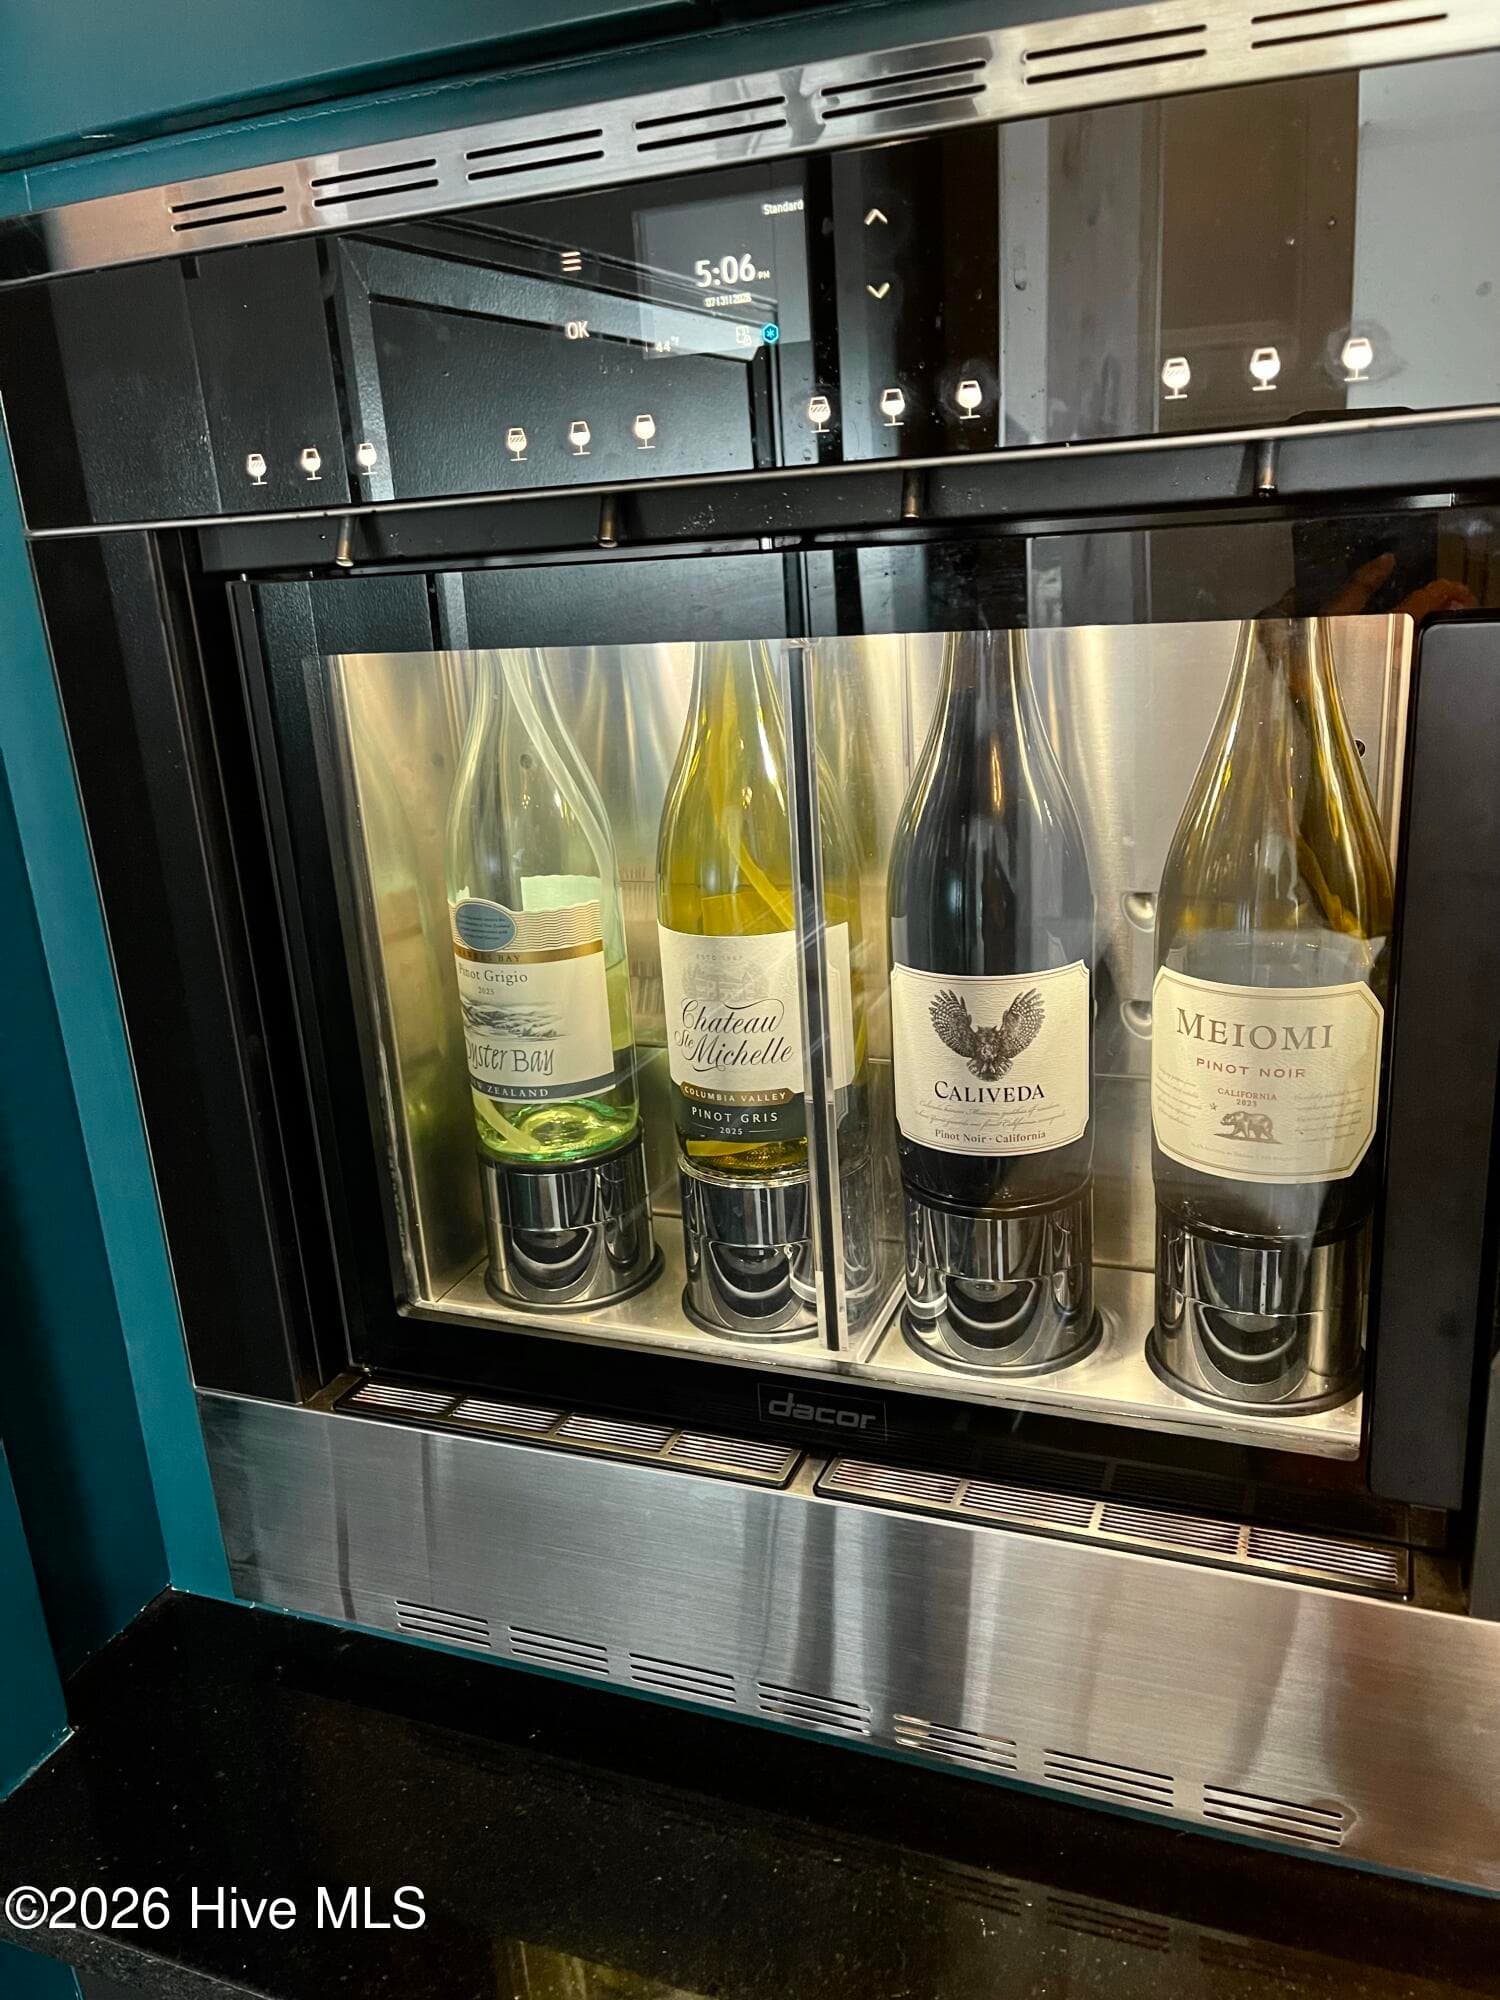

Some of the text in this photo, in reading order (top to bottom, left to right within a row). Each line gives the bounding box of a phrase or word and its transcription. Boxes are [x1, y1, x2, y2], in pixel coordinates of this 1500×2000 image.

[762, 199, 804, 215] Standard
[695, 254, 771, 287] 5:06 PM
[565, 321, 590, 340] OK
[484, 969, 528, 987] Grigio
[681, 998, 784, 1034] Chateau
[1176, 1007, 1334, 1051] MEIOMI
[510, 1048, 554, 1076] Bay
[682, 1034, 795, 1072] Michelle
[1196, 1057, 1306, 1078] PINOT NOIR
[487, 1085, 549, 1097] ZEALAND
[684, 1086, 786, 1102] COLUMBIA VALLEY
[1217, 1087, 1277, 1101] CALIFORNIA
[691, 1106, 778, 1123] PINOT GRIS
[720, 1127, 743, 1135] 2025
[935, 1129, 1046, 1143] Pinot Noir California
[768, 1392, 876, 1428] dacor
